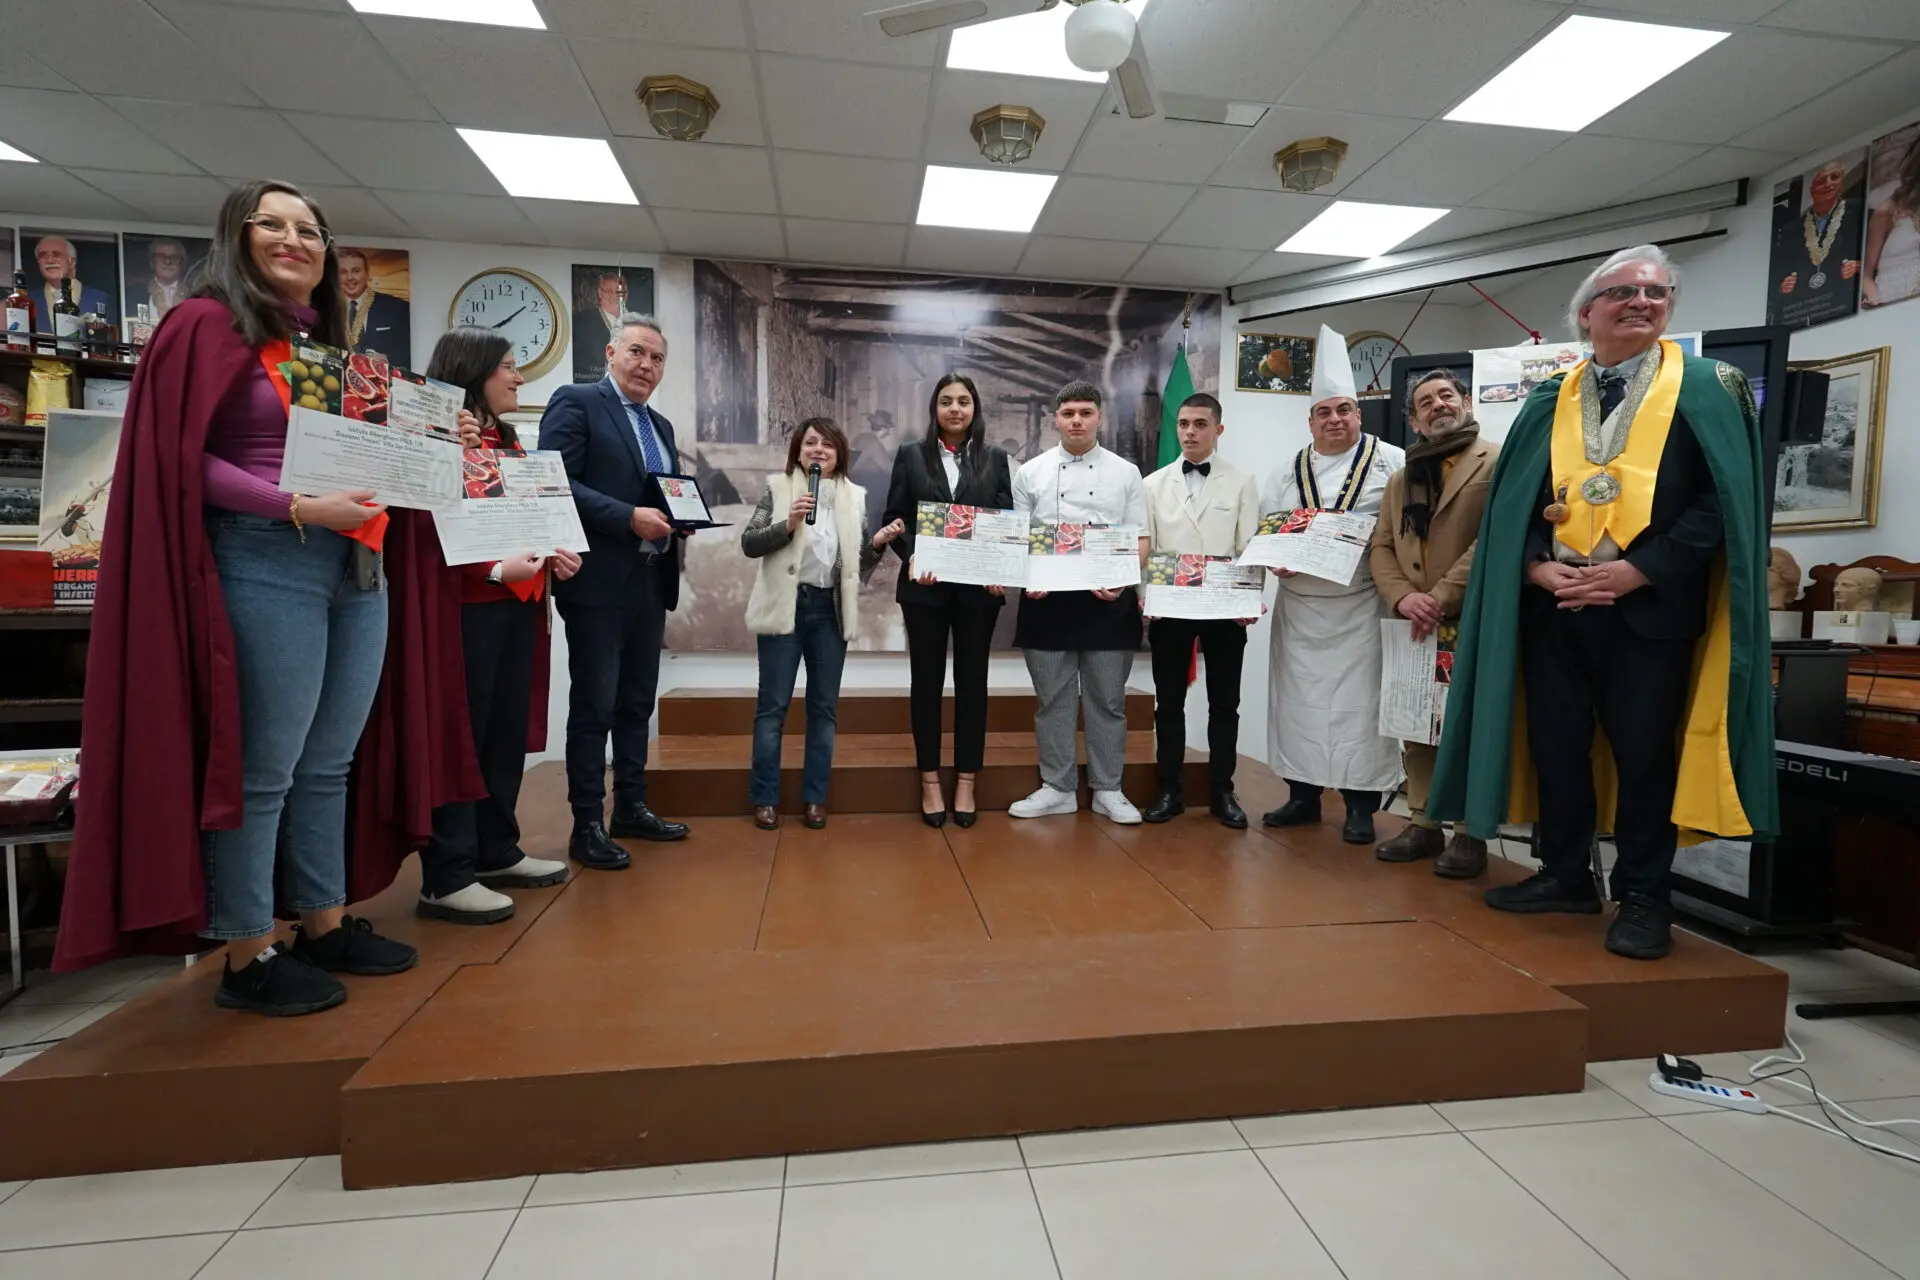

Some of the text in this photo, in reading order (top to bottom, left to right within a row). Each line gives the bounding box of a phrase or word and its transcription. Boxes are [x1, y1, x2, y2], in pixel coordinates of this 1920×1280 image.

[483, 288, 494, 300] 11
[498, 284, 512, 296] 12
[520, 290, 525, 301] 1
[471, 301, 485, 312] 10
[530, 301, 538, 312] 2
[465, 315, 475, 325] 9
[538, 319, 545, 330] 3
[531, 335, 539, 345] 4
[520, 346, 528, 358] 5
[1360, 350, 1368, 361] 11
[1372, 346, 1385, 357] 12
